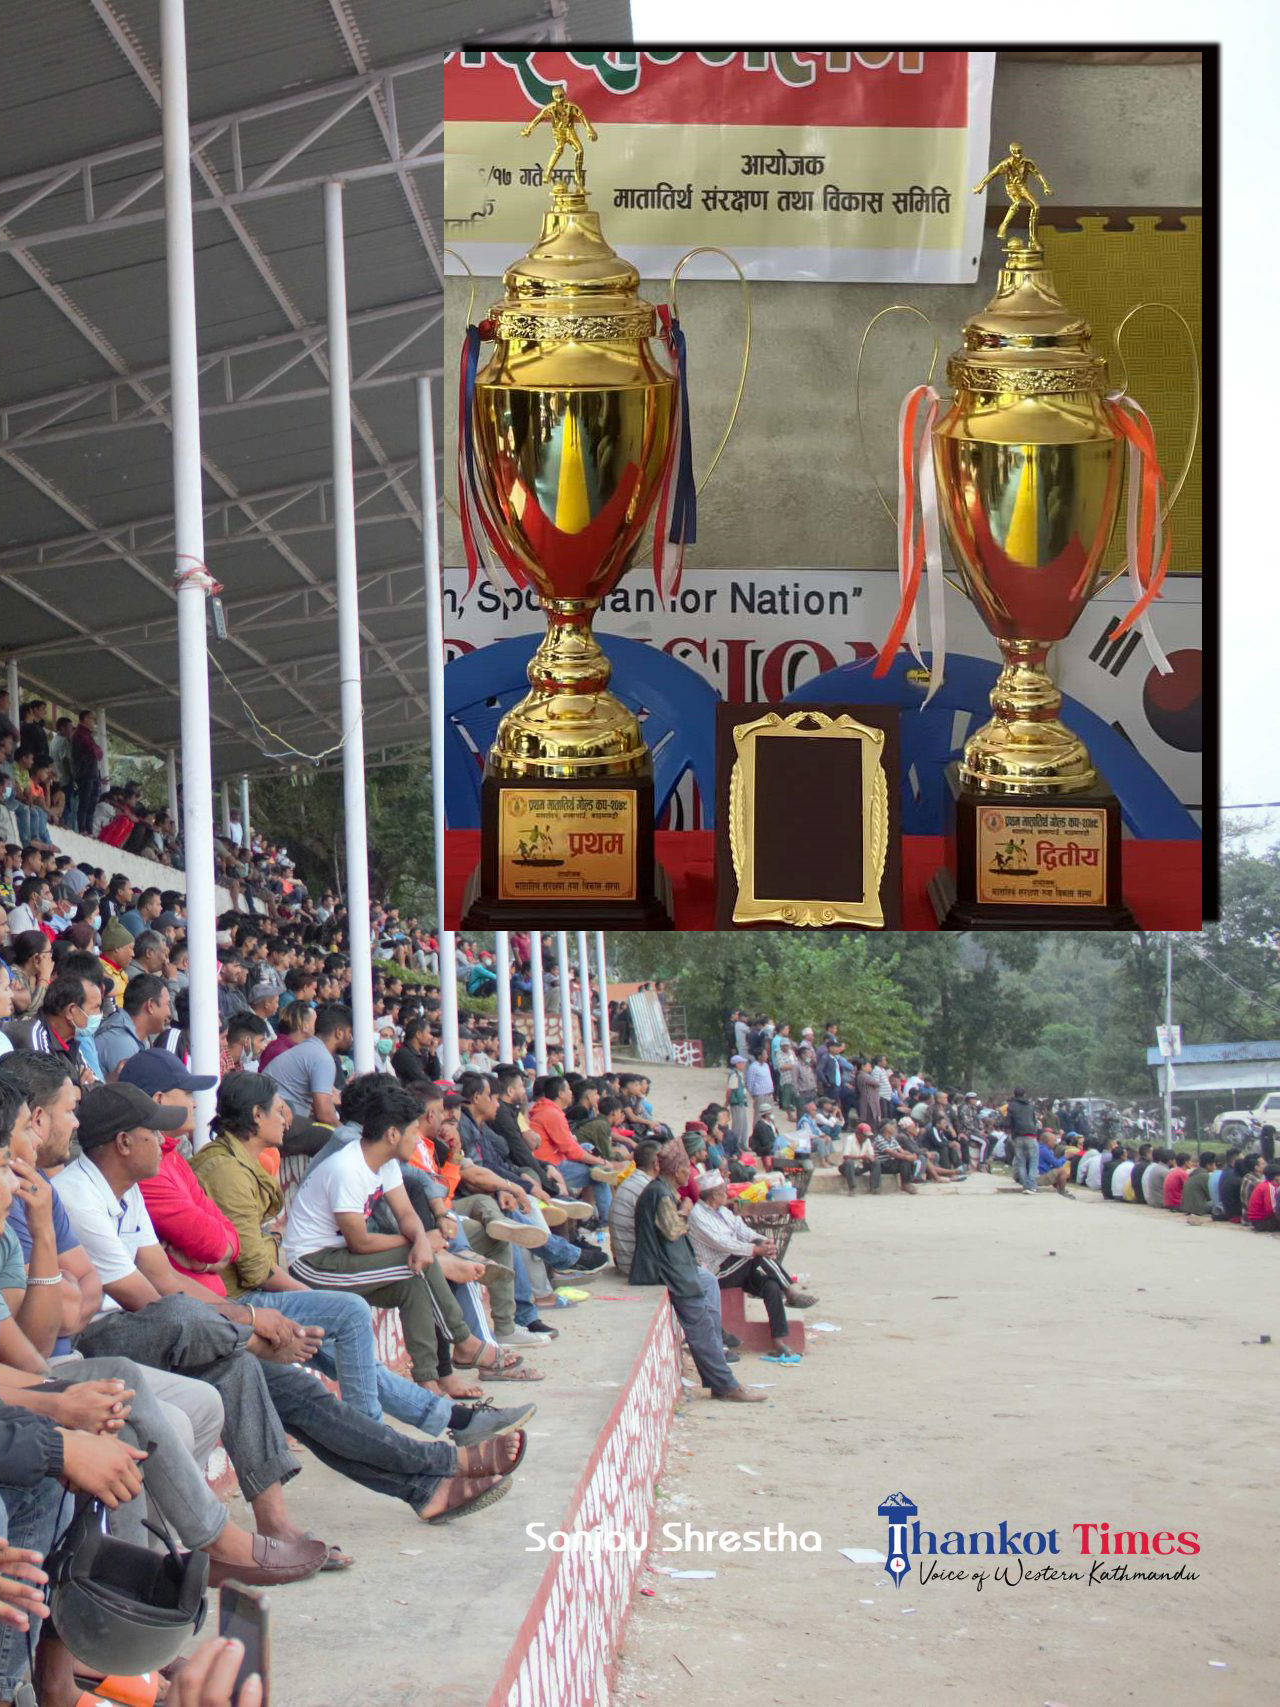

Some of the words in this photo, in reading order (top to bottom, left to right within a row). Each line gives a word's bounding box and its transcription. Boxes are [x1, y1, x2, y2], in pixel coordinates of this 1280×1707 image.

[741, 149, 825, 176] आयोजक
[613, 182, 693, 210] मातातिर्थ
[701, 185, 769, 213] संरक्षण
[777, 189, 813, 212] तथा
[822, 184, 884, 214] विकास
[892, 185, 951, 214] समिति
[568, 832, 625, 858] प्रथम
[1036, 840, 1100, 871] द्वितीय
